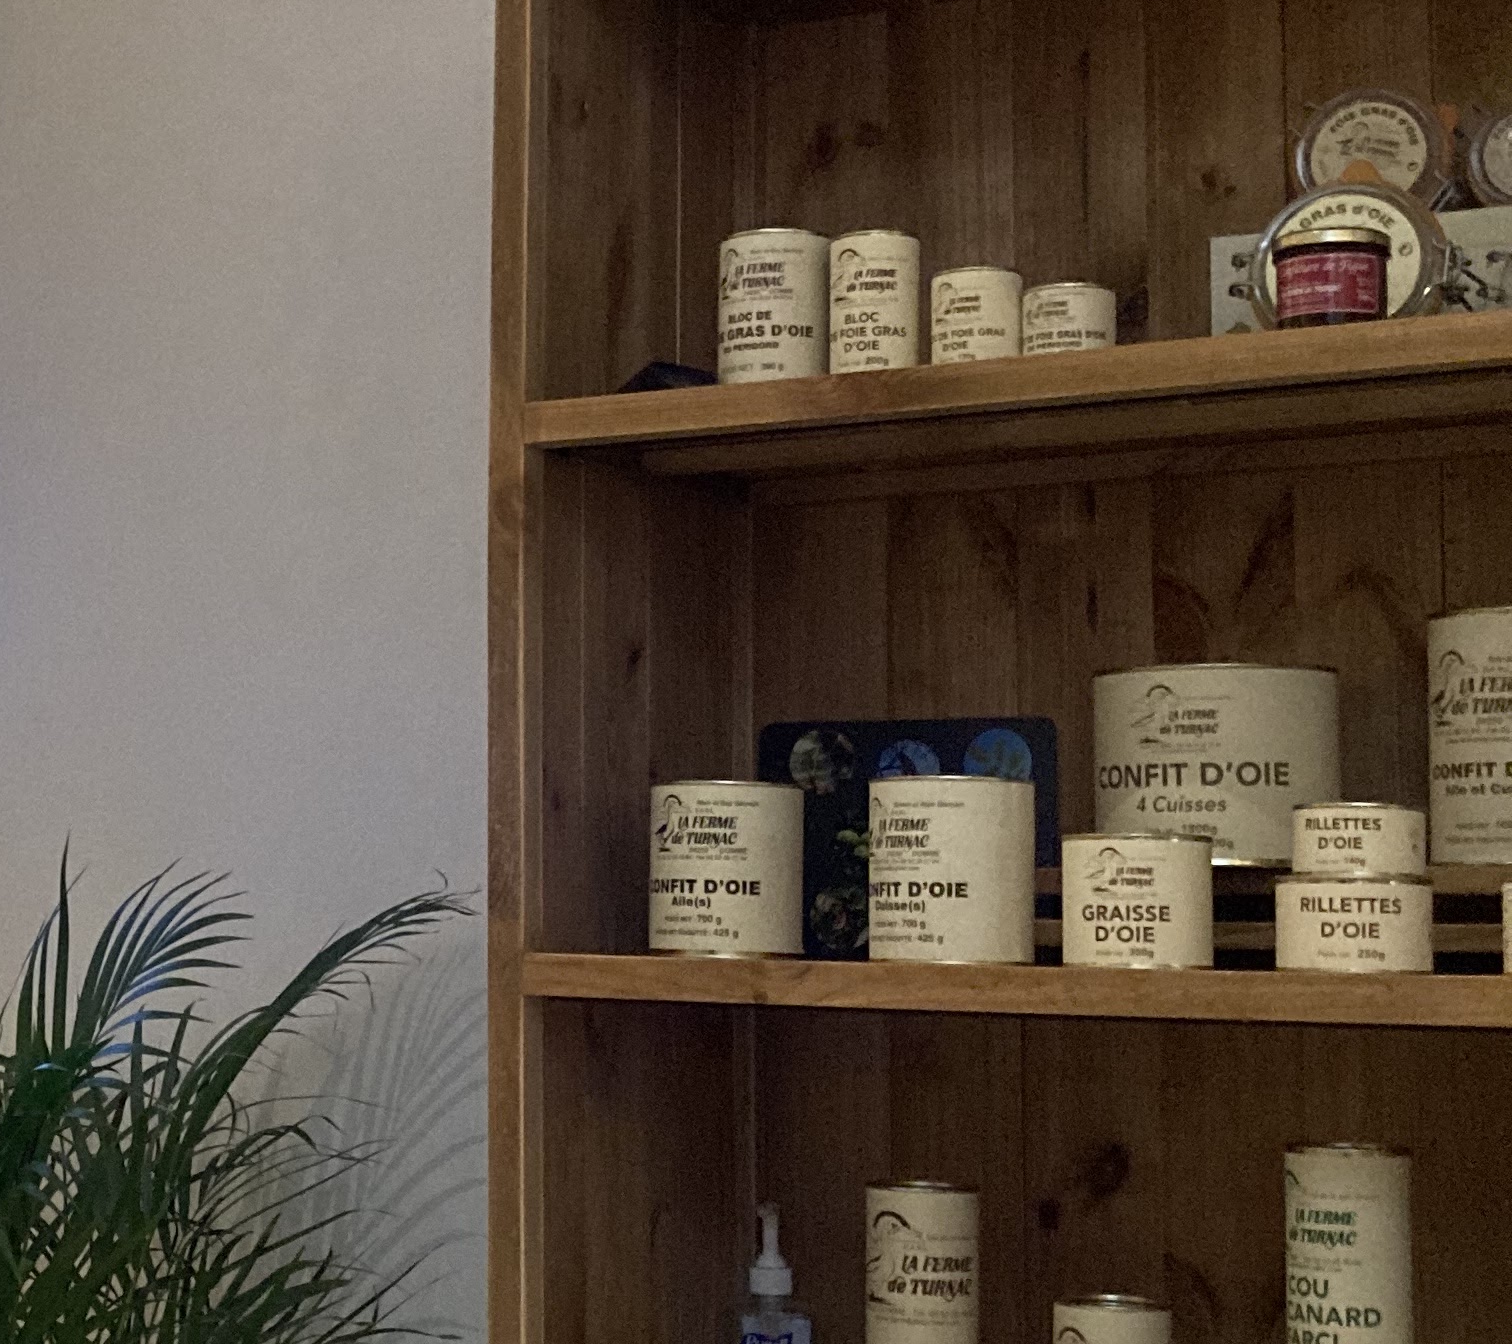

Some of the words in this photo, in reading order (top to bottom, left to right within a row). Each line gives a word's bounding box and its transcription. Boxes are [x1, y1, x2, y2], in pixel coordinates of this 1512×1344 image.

[756, 310, 772, 321] DE
[844, 311, 880, 325] BLOC
[727, 325, 765, 341] GRAS
[771, 324, 814, 338] D'OIE
[840, 326, 867, 339] FOIE
[872, 324, 907, 338] GRAS
[844, 340, 880, 354] D'OIE
[1099, 762, 1188, 790] CONFIT
[1199, 761, 1290, 788] D'OIE
[1433, 761, 1498, 779] CONFIT
[1136, 795, 1146, 812] 4
[1152, 794, 1227, 814] Cuisses
[691, 816, 738, 830] FERME
[888, 818, 931, 832] FERME
[1305, 817, 1382, 831] RILLETTES
[687, 831, 738, 848] TURNAC
[1318, 836, 1363, 850] D'OIE
[704, 879, 761, 896] D'OIE
[908, 882, 968, 898] D'OIE
[1082, 904, 1171, 922] GRAISSE
[1300, 896, 1402, 915] RILLETTES
[1095, 926, 1155, 943] D'OIE
[1320, 921, 1381, 939] D'OIE
[922, 1256, 973, 1274] FERME
